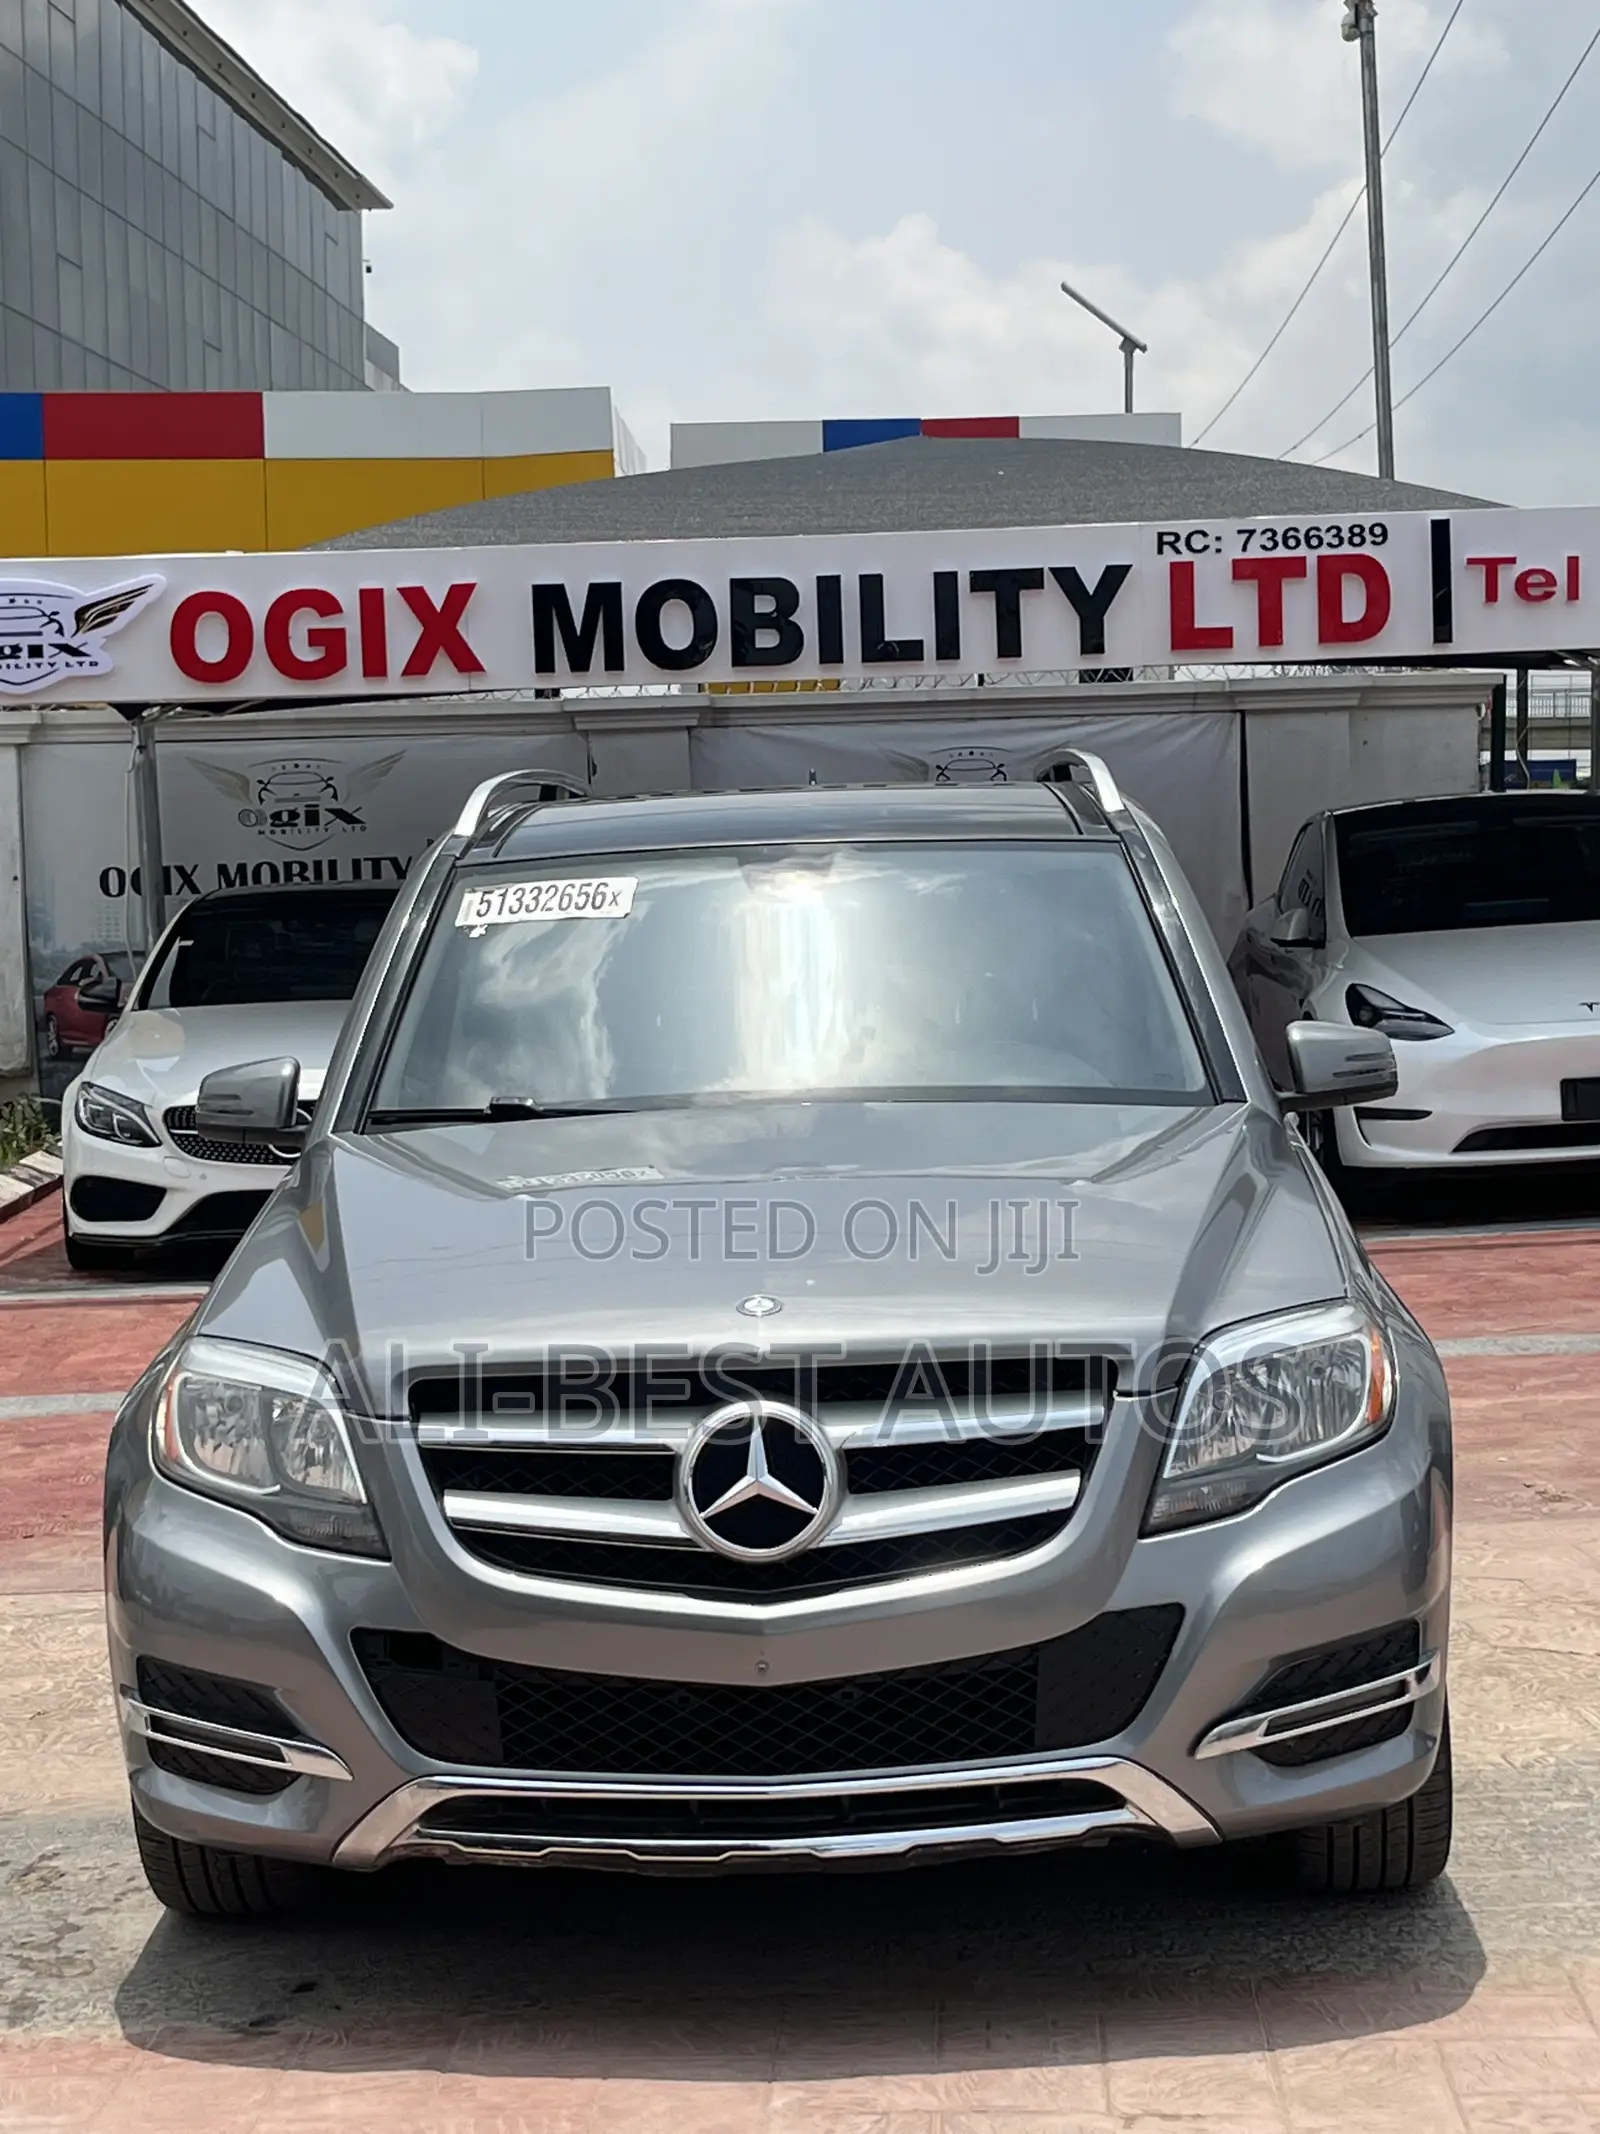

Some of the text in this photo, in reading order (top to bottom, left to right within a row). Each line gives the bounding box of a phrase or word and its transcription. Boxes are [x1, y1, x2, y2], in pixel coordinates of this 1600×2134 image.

[1156, 522, 1389, 555] RC: 7366389
[170, 553, 1580, 683] OGIX MOBILITY LTD Tel
[0, 661, 57, 669] ILITY
[217, 856, 413, 890] MOBILITY
